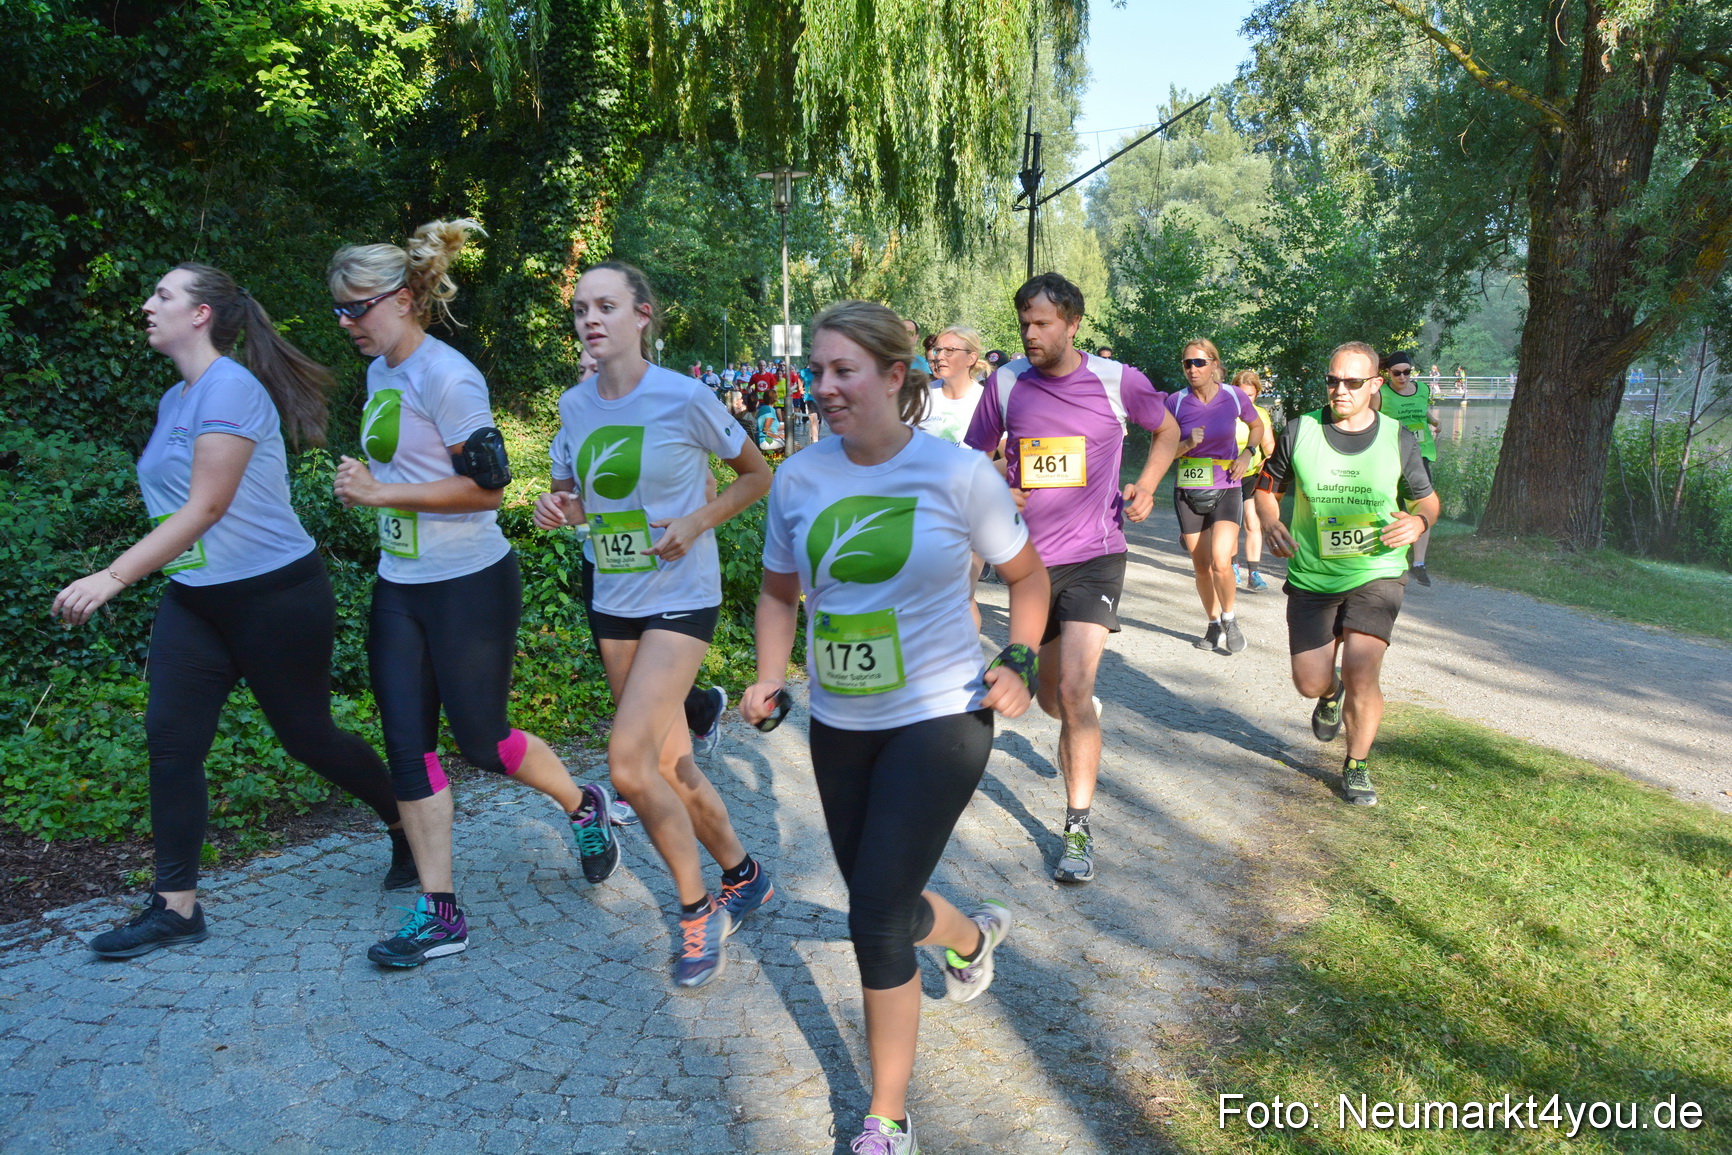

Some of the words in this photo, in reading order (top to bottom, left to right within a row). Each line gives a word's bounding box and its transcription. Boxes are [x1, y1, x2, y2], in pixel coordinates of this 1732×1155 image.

[1033, 454, 1067, 473] 461
[1183, 468, 1204, 479] 462
[1317, 482, 1373, 495] Laufgruppe
[601, 533, 636, 556] 142
[1331, 529, 1364, 547] 550
[825, 641, 876, 672] 173
